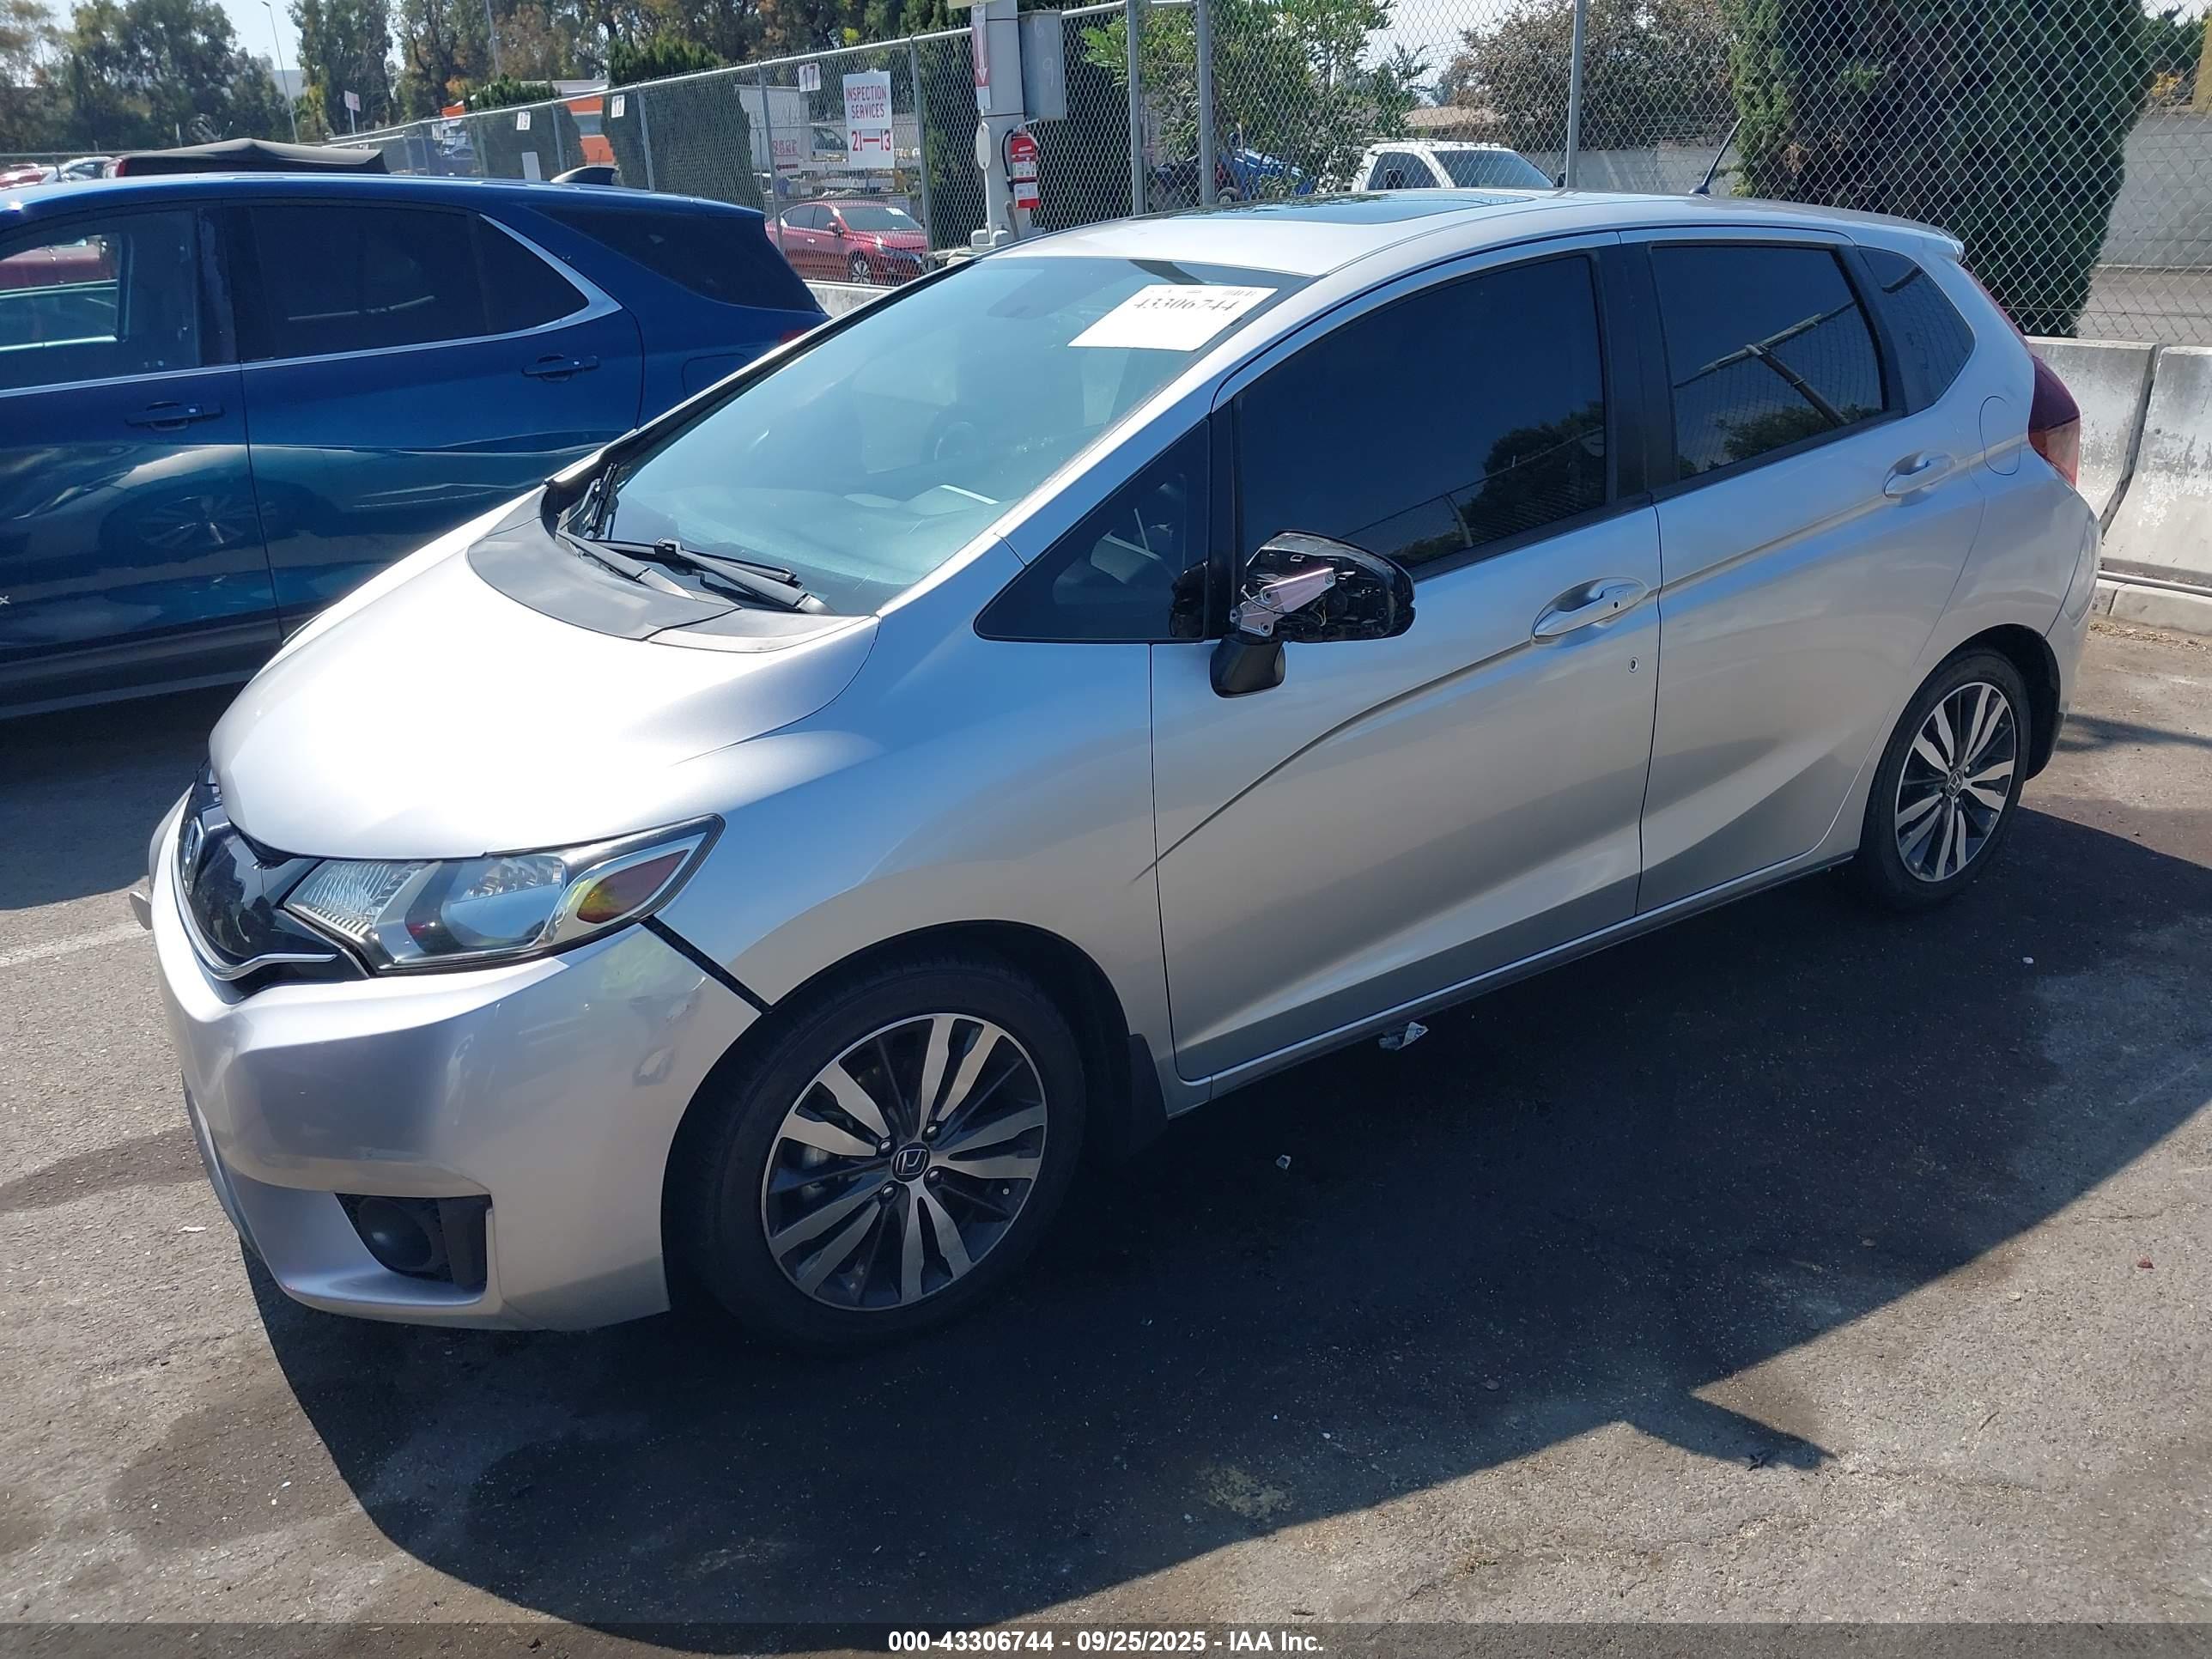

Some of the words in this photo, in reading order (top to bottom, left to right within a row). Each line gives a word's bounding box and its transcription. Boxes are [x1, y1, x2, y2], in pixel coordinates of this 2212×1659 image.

[802, 64, 816, 90] 17
[846, 85, 887, 101] INSPECTION
[851, 103, 885, 119] SERVICES
[1133, 297, 1239, 311] 43306744
